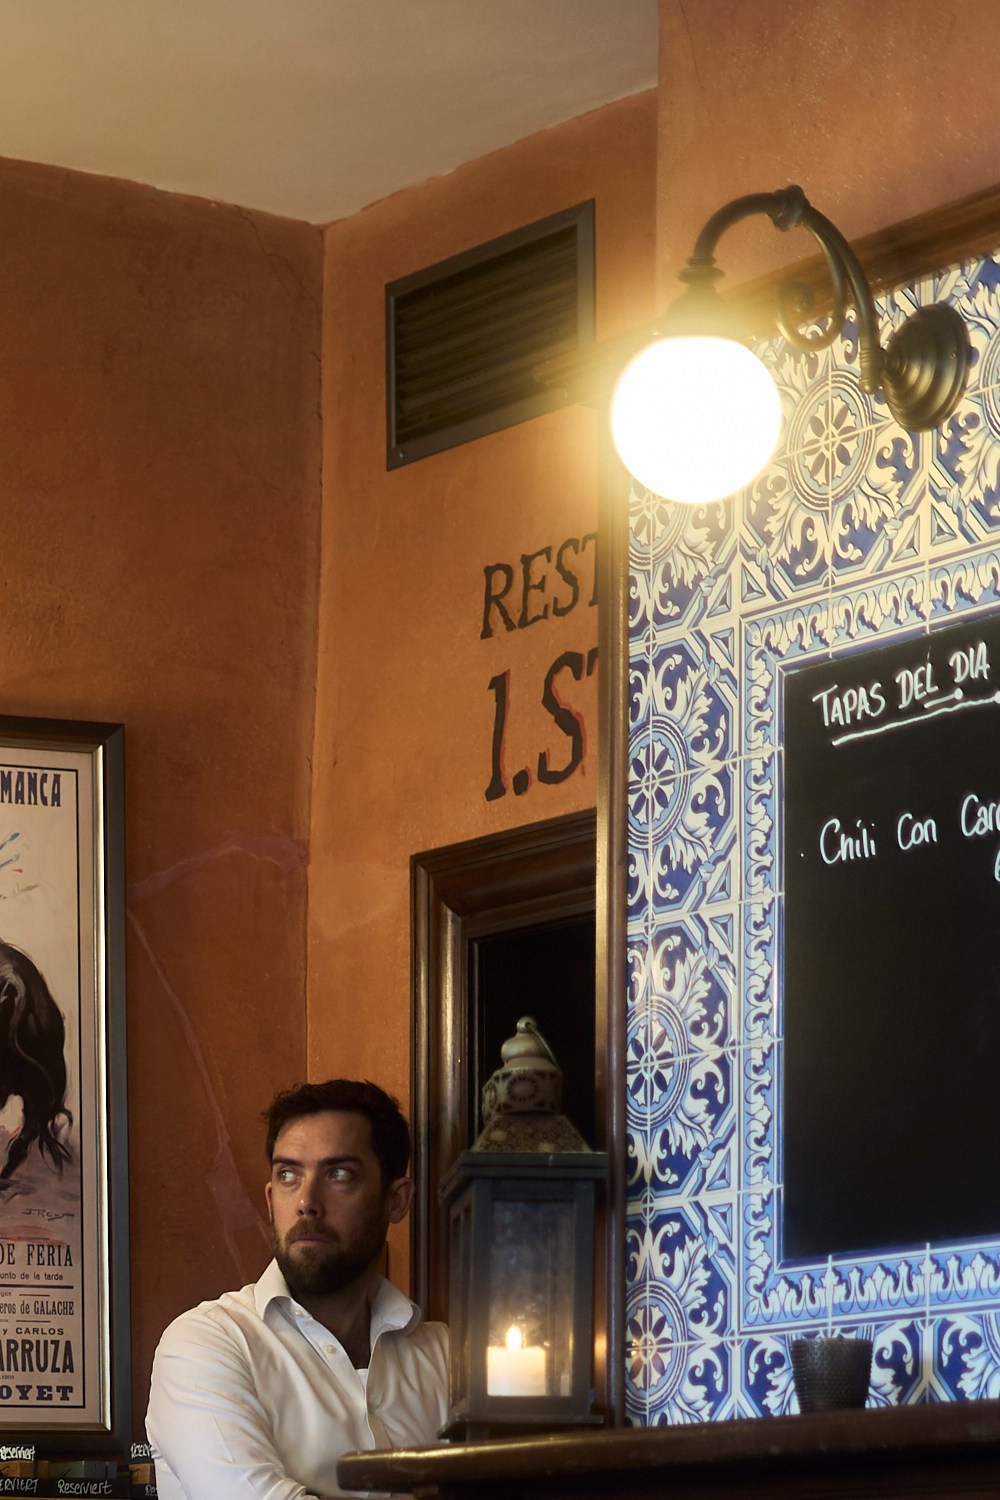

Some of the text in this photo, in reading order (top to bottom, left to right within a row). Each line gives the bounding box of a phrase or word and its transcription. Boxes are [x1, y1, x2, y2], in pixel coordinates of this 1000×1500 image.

[812, 641, 991, 727] TAPAS DEL DIA
[485, 646, 599, 802] 1.S
[819, 794, 1000, 865] Chili Con Car
[26, 1244, 74, 1267] FERIA
[20, 1272, 30, 1280] de
[34, 1272, 40, 1280] la
[44, 1272, 64, 1281] tarde
[20, 1300, 30, 1314] de
[34, 1300, 74, 1316] GALACHE
[2, 1327, 64, 1336] y CARLOS
[58, 1478, 113, 1496] Reserviert
